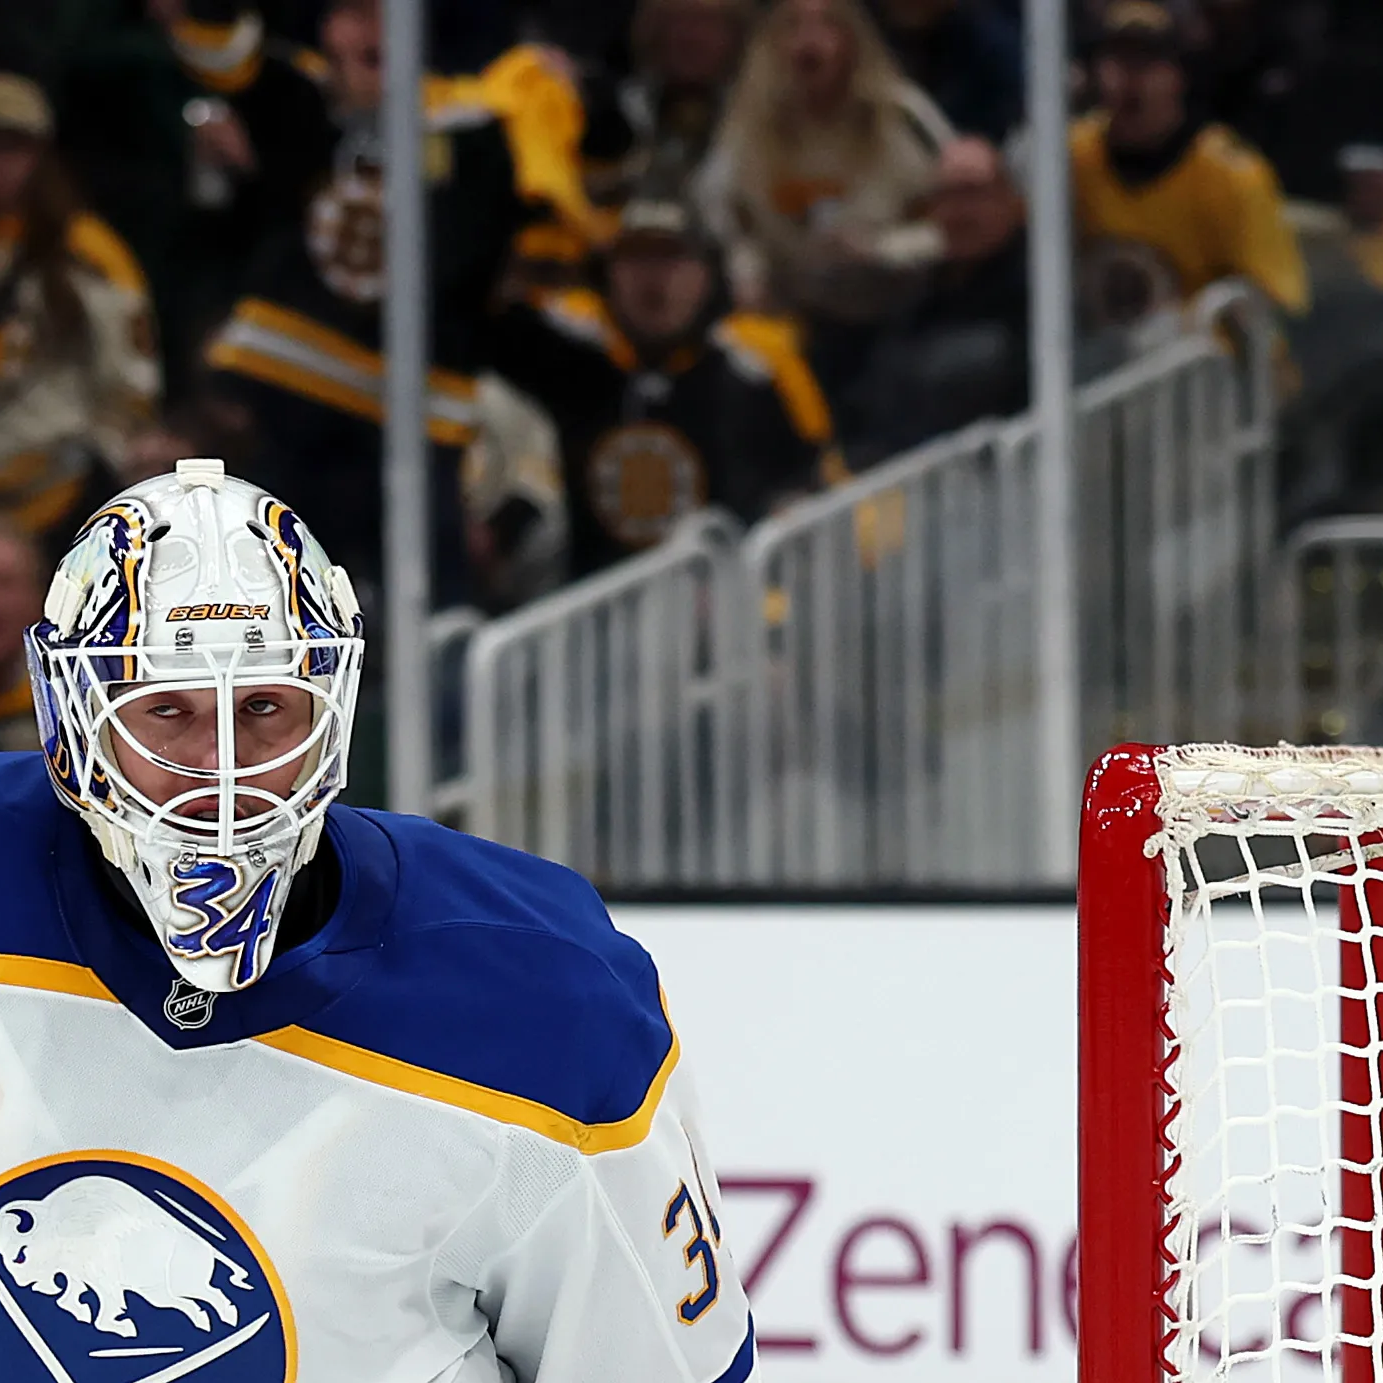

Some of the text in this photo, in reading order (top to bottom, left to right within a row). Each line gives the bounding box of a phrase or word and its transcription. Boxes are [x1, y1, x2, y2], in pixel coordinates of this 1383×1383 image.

[165, 604, 270, 622] BAUER
[167, 855, 281, 990] 34
[173, 995, 207, 1014] NHL
[661, 1177, 721, 1326] 3
